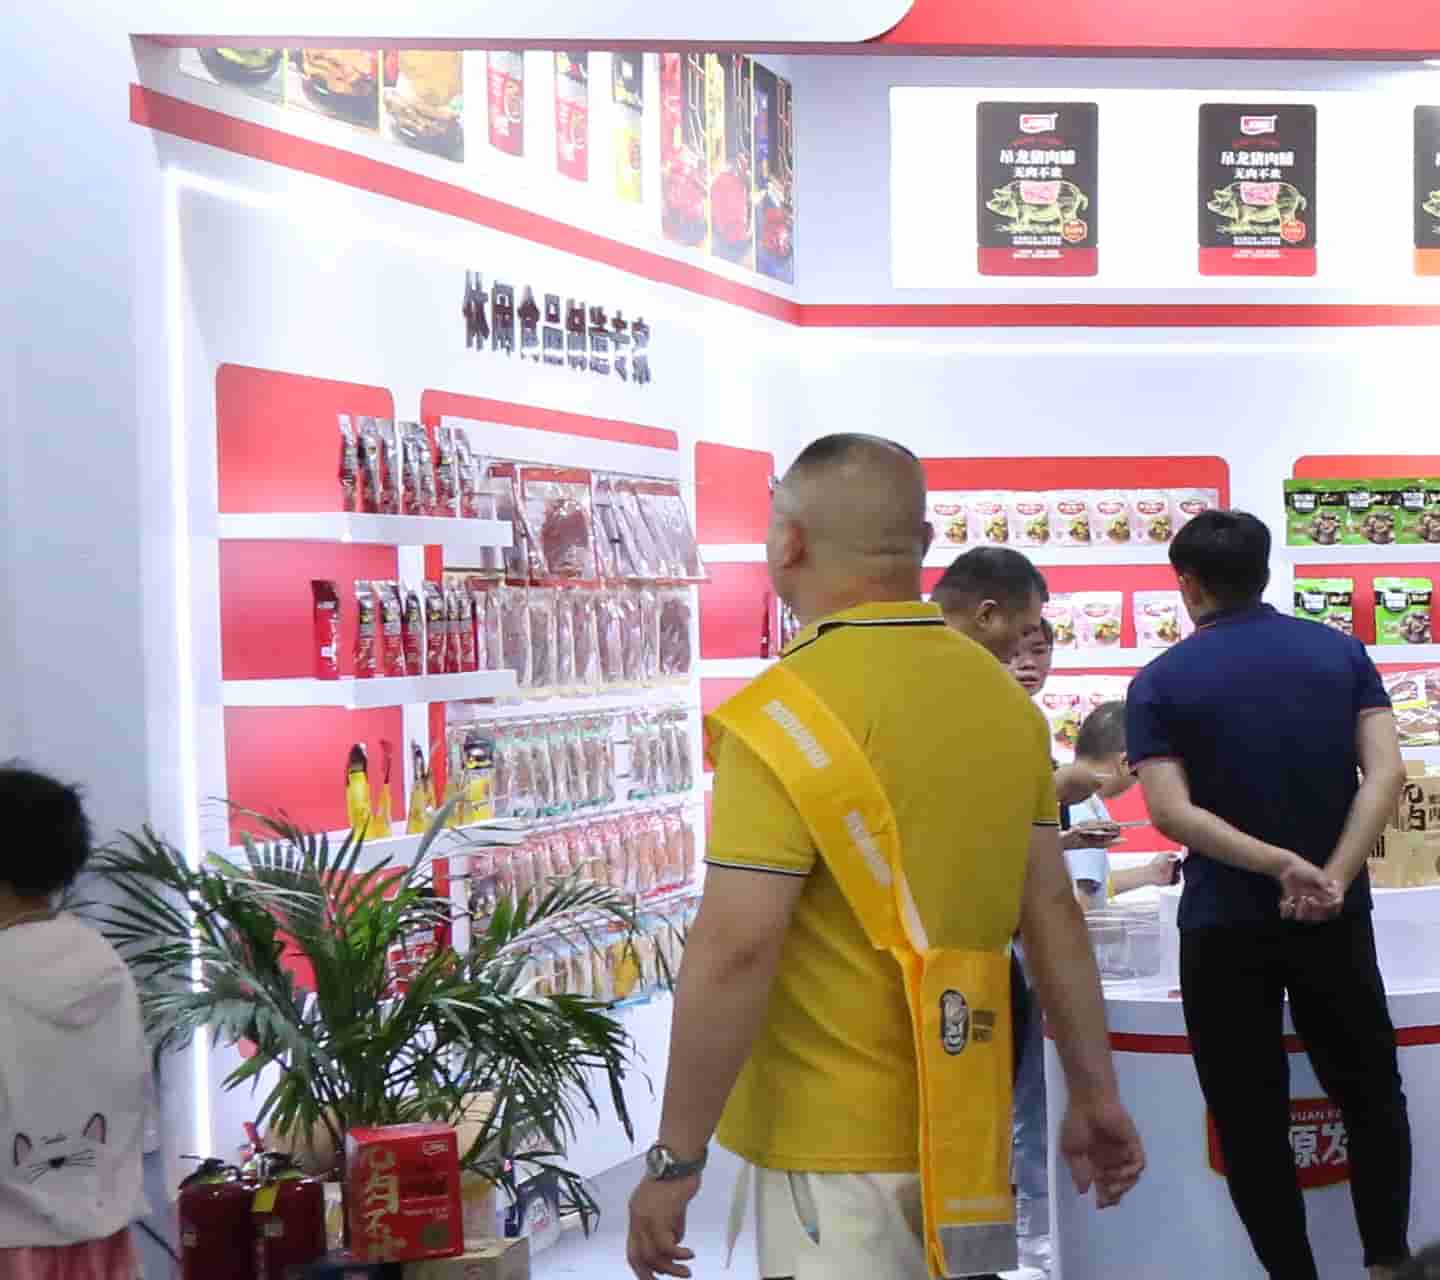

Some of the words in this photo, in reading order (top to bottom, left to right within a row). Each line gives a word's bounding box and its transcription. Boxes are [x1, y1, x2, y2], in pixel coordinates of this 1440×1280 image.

[462, 268, 651, 387] 休闲食品制造专家
